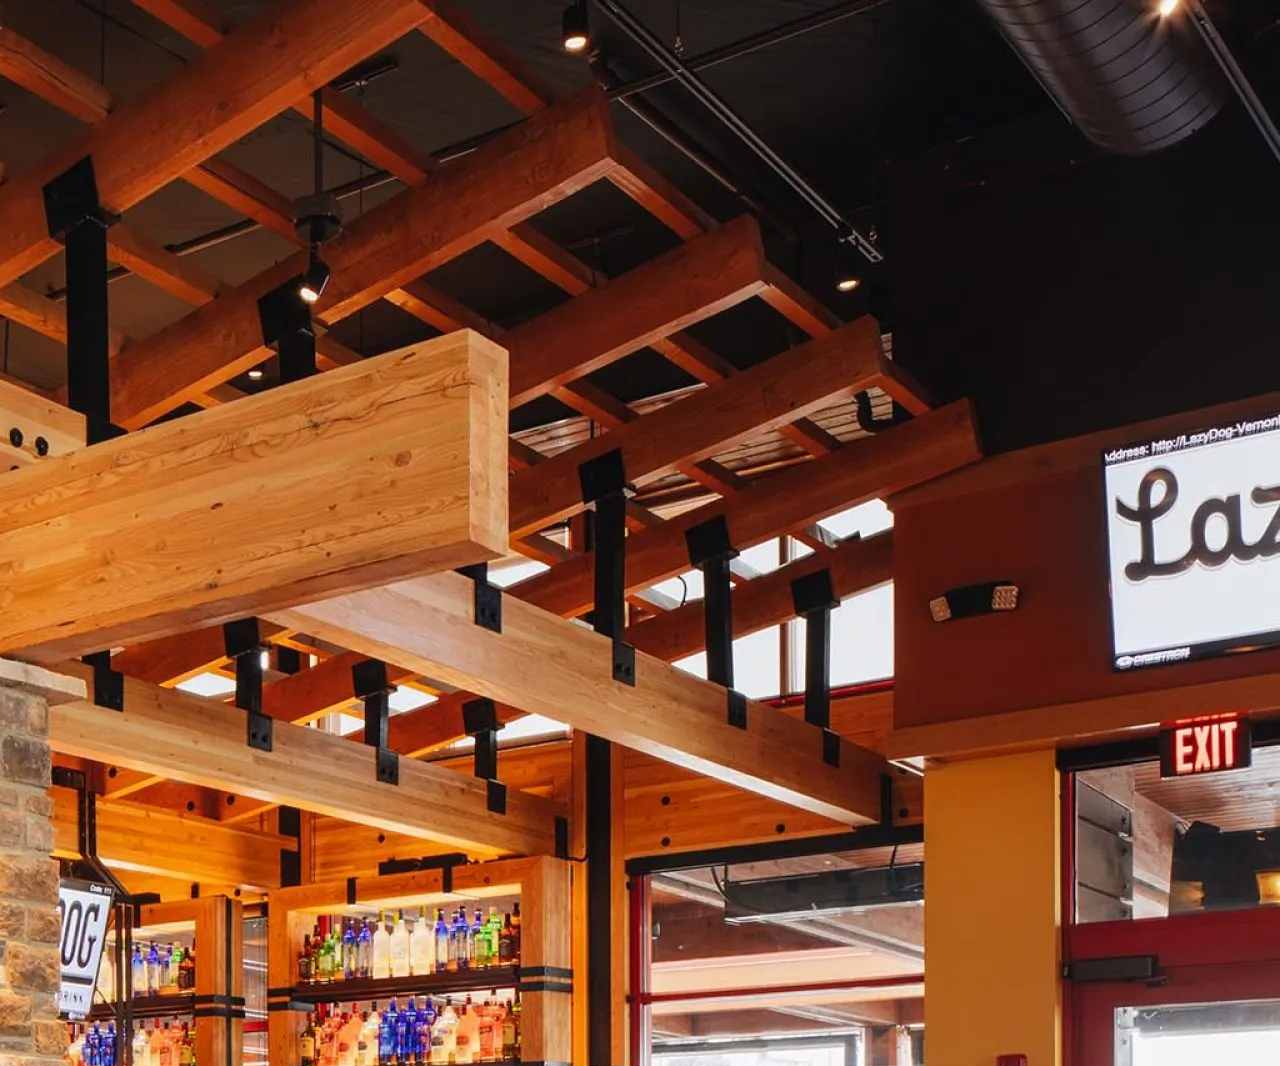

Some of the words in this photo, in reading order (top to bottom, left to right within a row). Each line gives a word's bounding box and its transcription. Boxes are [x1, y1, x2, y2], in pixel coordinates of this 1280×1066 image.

[1151, 413, 1280, 452] http://LazyDog-Vernon
[1176, 721, 1238, 774] EXIT
[59, 899, 100, 969] OG
